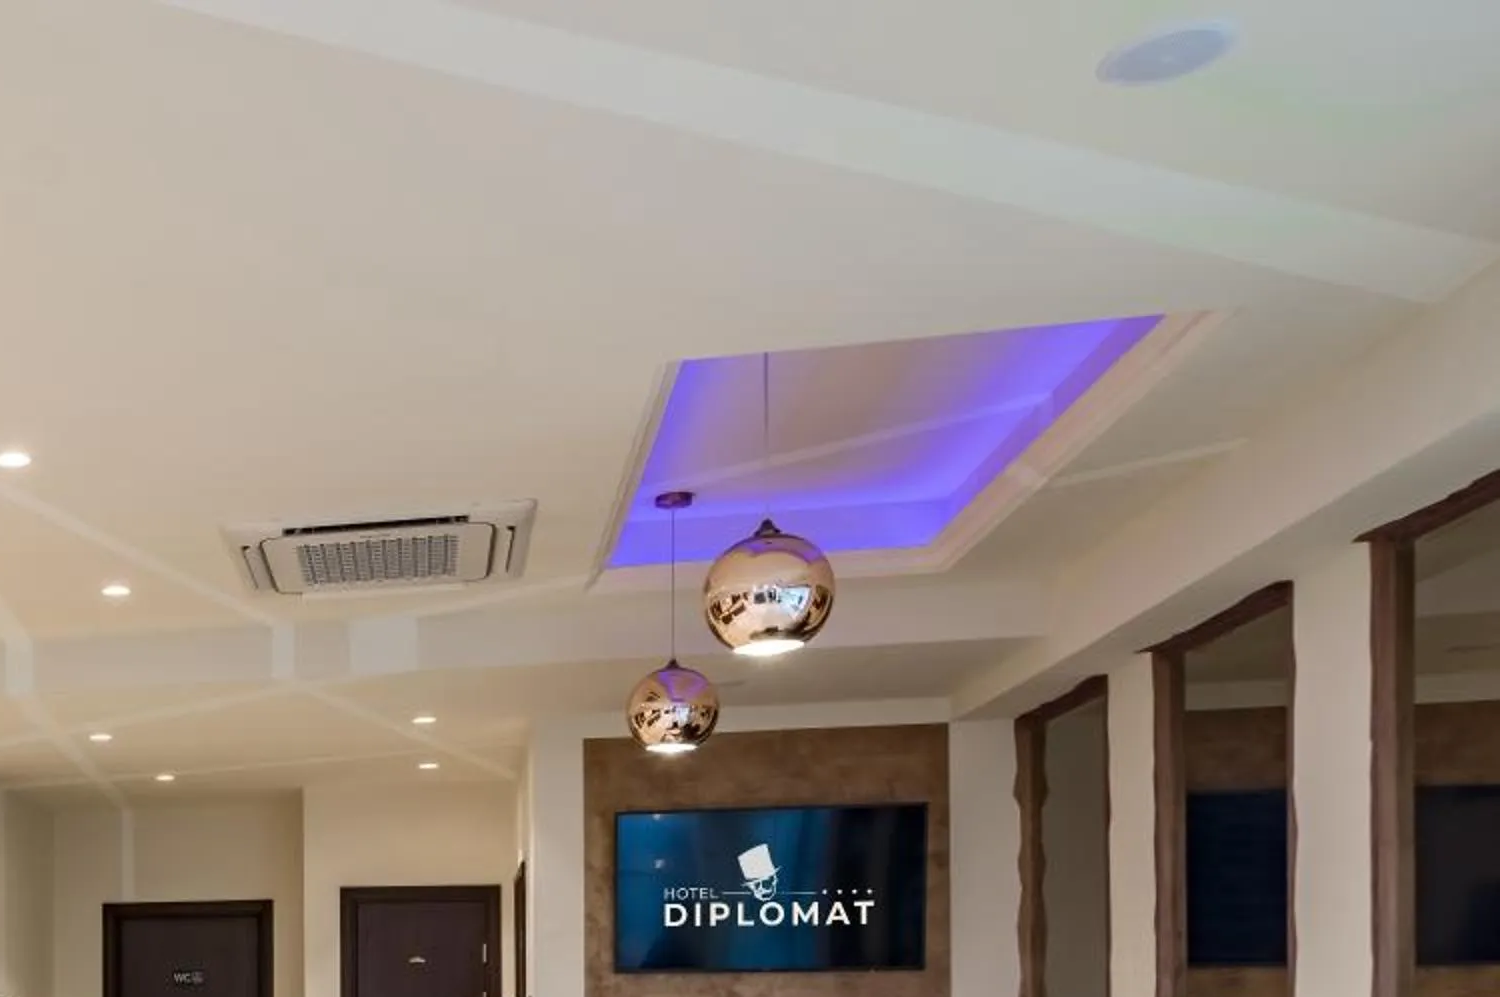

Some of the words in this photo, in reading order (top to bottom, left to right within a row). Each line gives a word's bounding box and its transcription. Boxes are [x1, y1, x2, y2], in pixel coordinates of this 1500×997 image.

[663, 887, 720, 900] HOTEL
[663, 900, 876, 928] DIPLOMAT
[173, 971, 191, 984] WC
